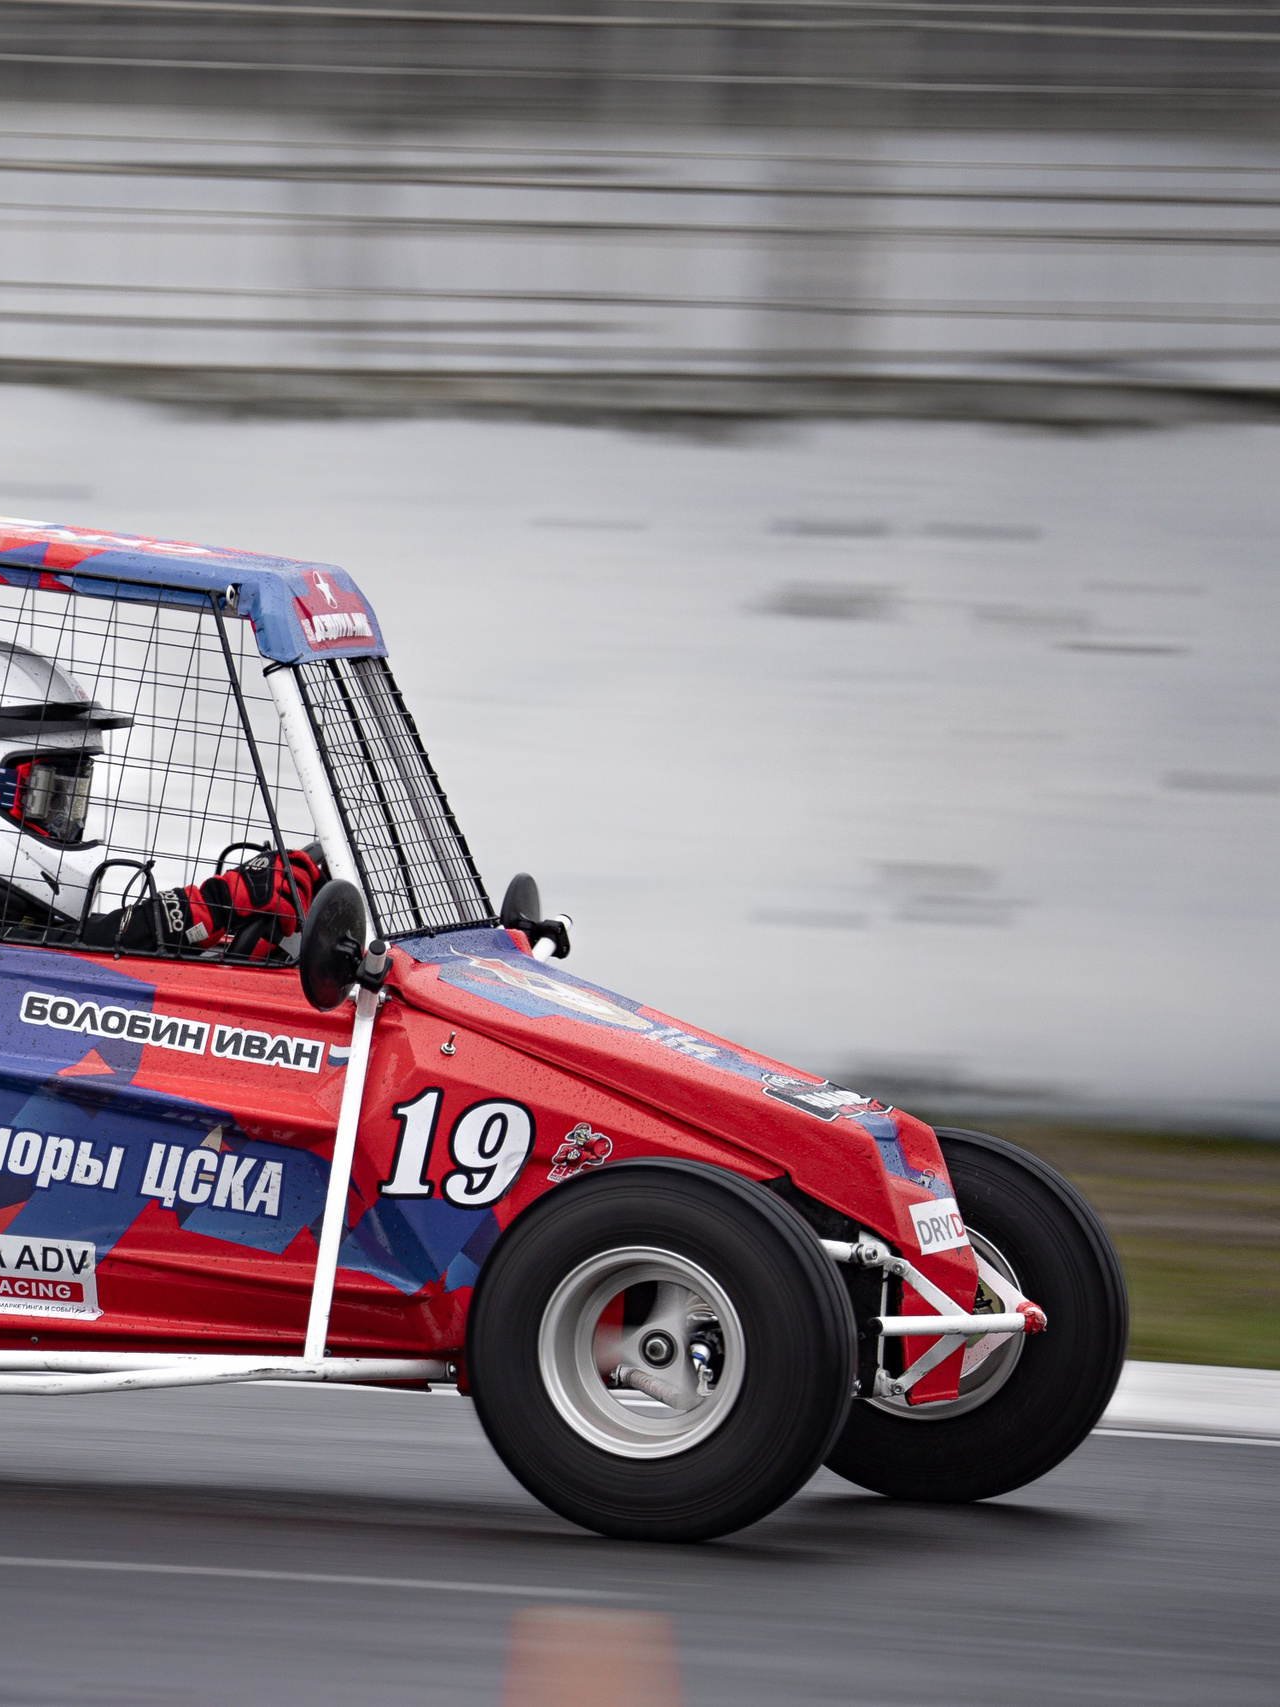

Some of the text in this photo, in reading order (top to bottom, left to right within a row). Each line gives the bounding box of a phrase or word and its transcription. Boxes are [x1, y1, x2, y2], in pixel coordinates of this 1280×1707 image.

[23, 994, 321, 1069] БОЛОБИН ИВАН
[140, 1141, 284, 1217] ЦСКА
[378, 1088, 535, 1209] 19
[14, 1244, 89, 1276] ADV
